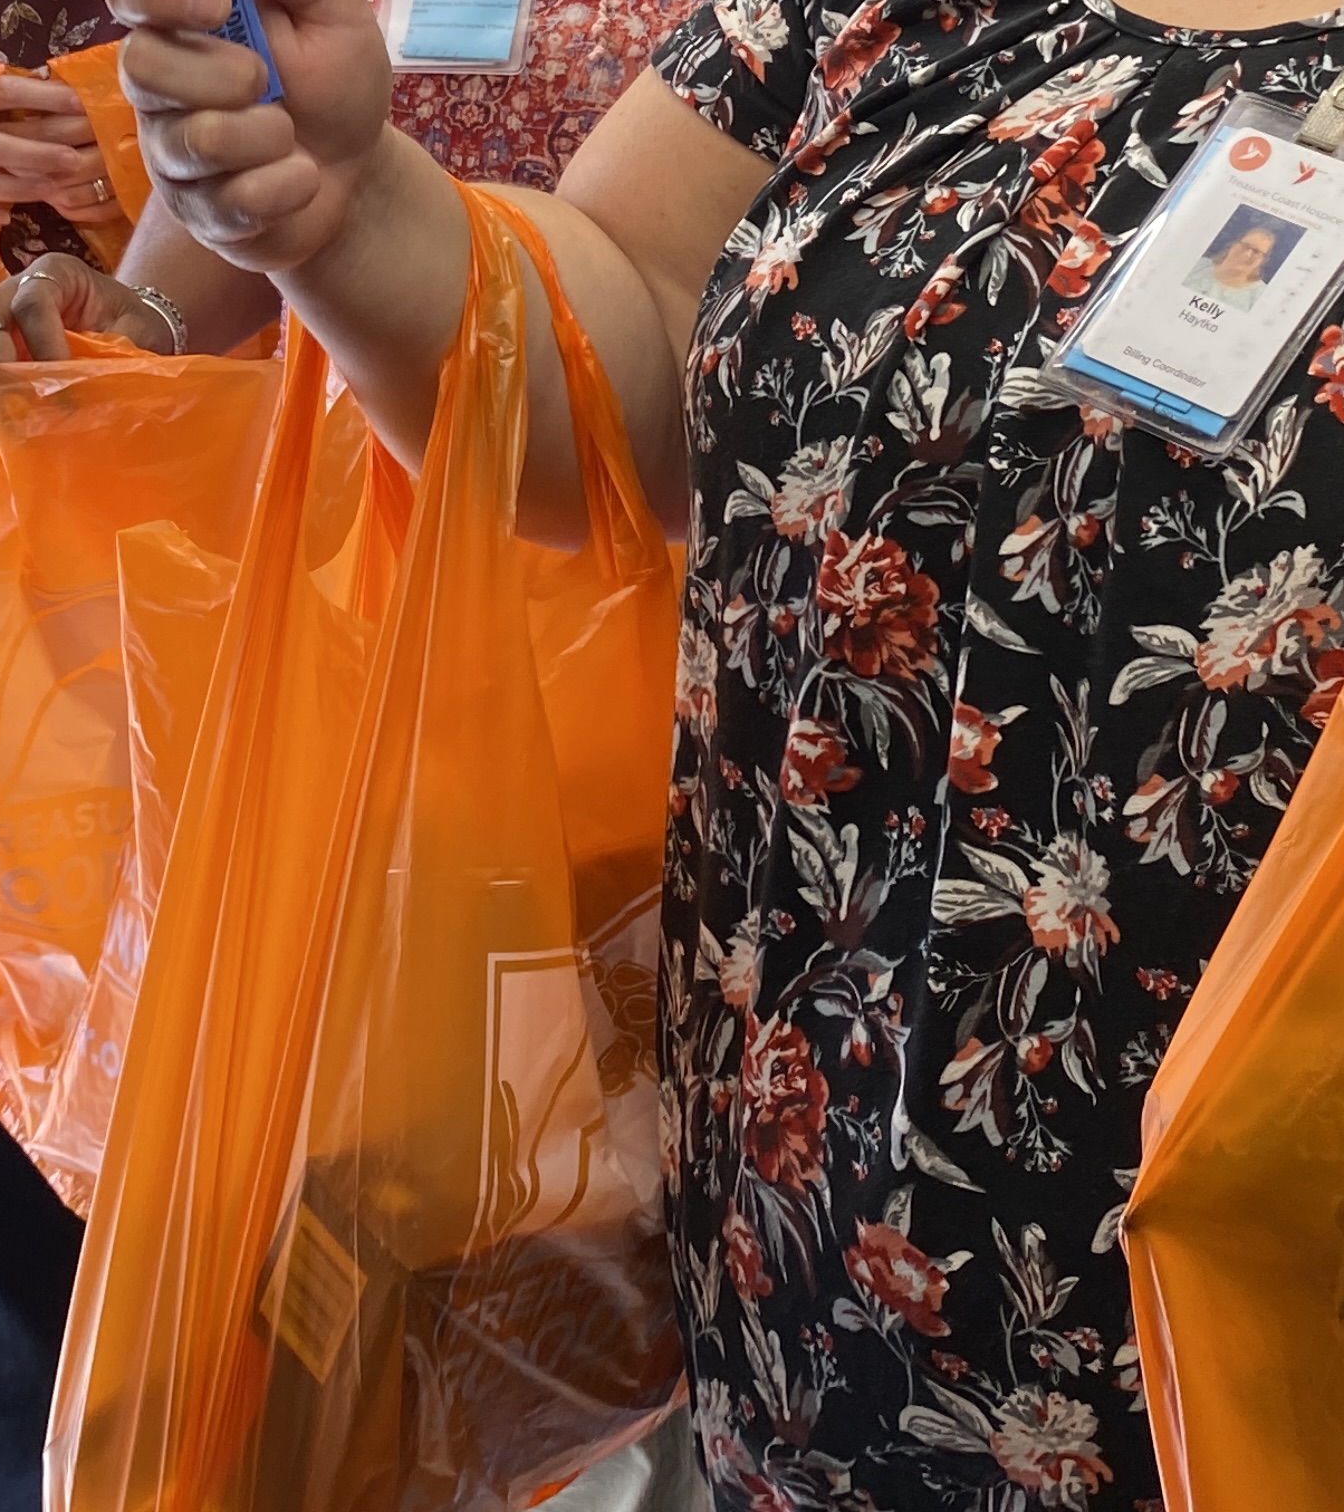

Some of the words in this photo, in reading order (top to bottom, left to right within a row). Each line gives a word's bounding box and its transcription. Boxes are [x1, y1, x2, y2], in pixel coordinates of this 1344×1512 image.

[1228, 174, 1271, 197] Treasure
[1270, 191, 1302, 210] Coast
[1302, 202, 1344, 226] Hospice
[1188, 295, 1225, 320] Kelly
[1123, 346, 1152, 366] Billing
[1152, 358, 1207, 388] Coordinator
